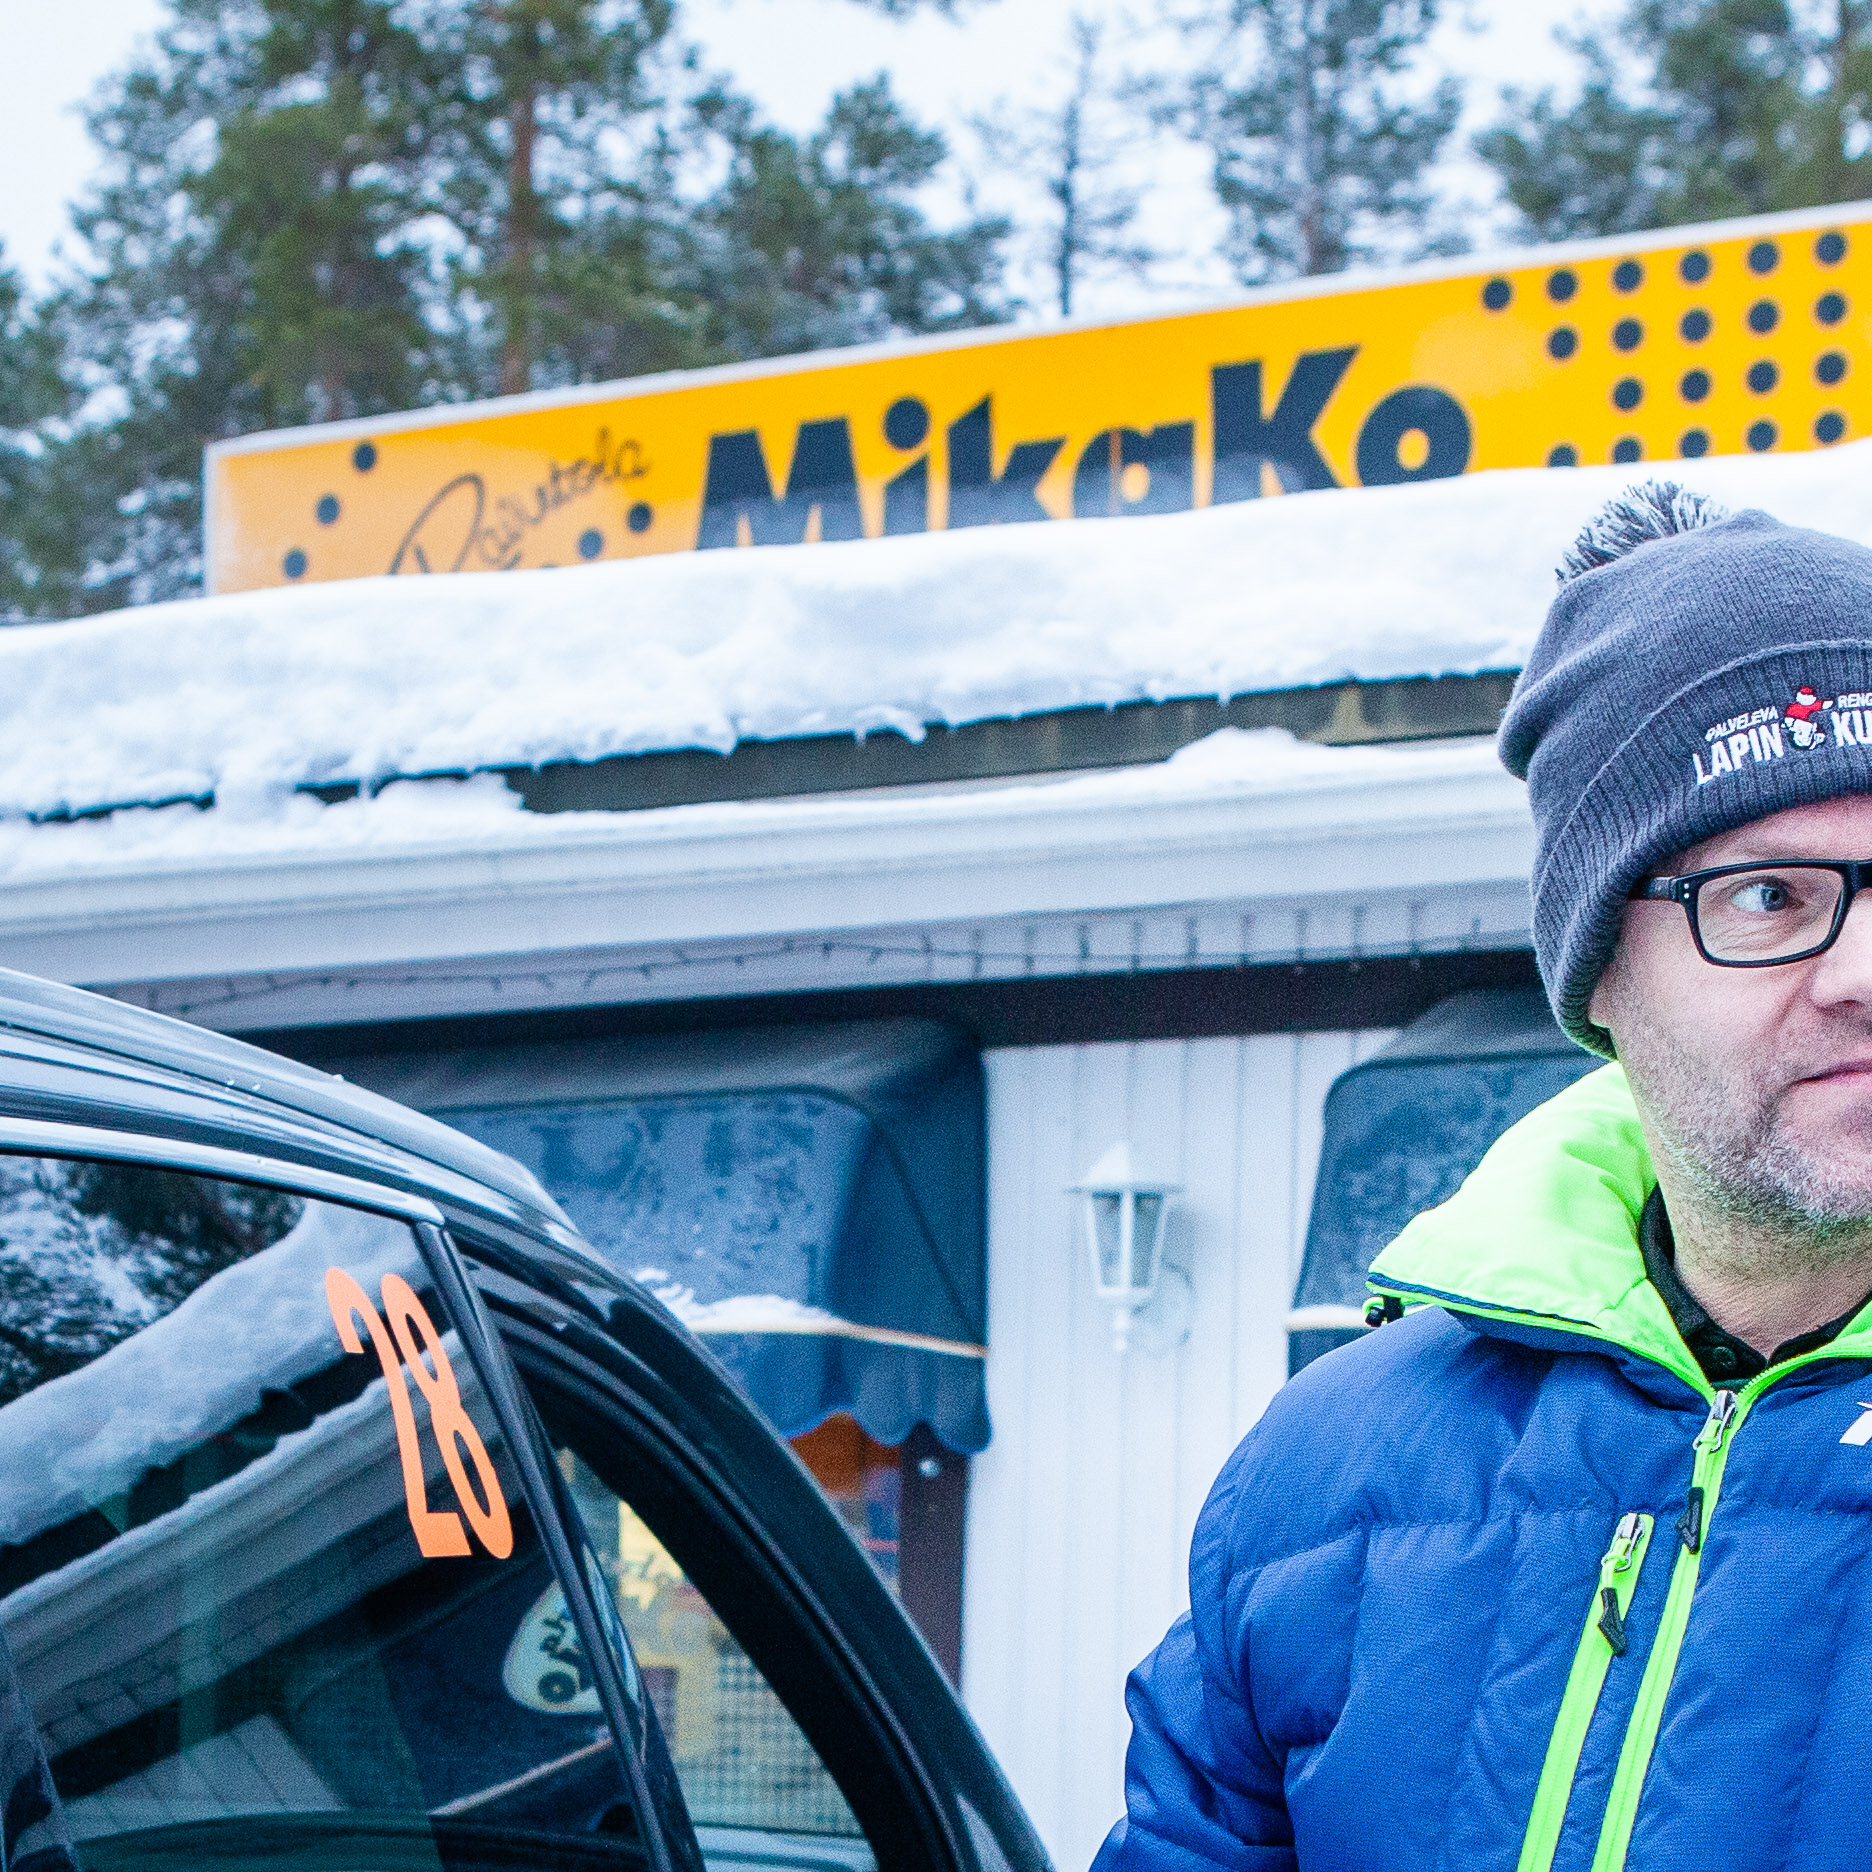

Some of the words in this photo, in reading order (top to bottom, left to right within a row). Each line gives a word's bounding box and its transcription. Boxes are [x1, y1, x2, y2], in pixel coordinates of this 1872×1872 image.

[694, 345, 1473, 551] MikaKo
[1692, 722, 1785, 786] LAPIN
[1705, 705, 1779, 743] PALVELEVA
[325, 1266, 514, 1560] 28
